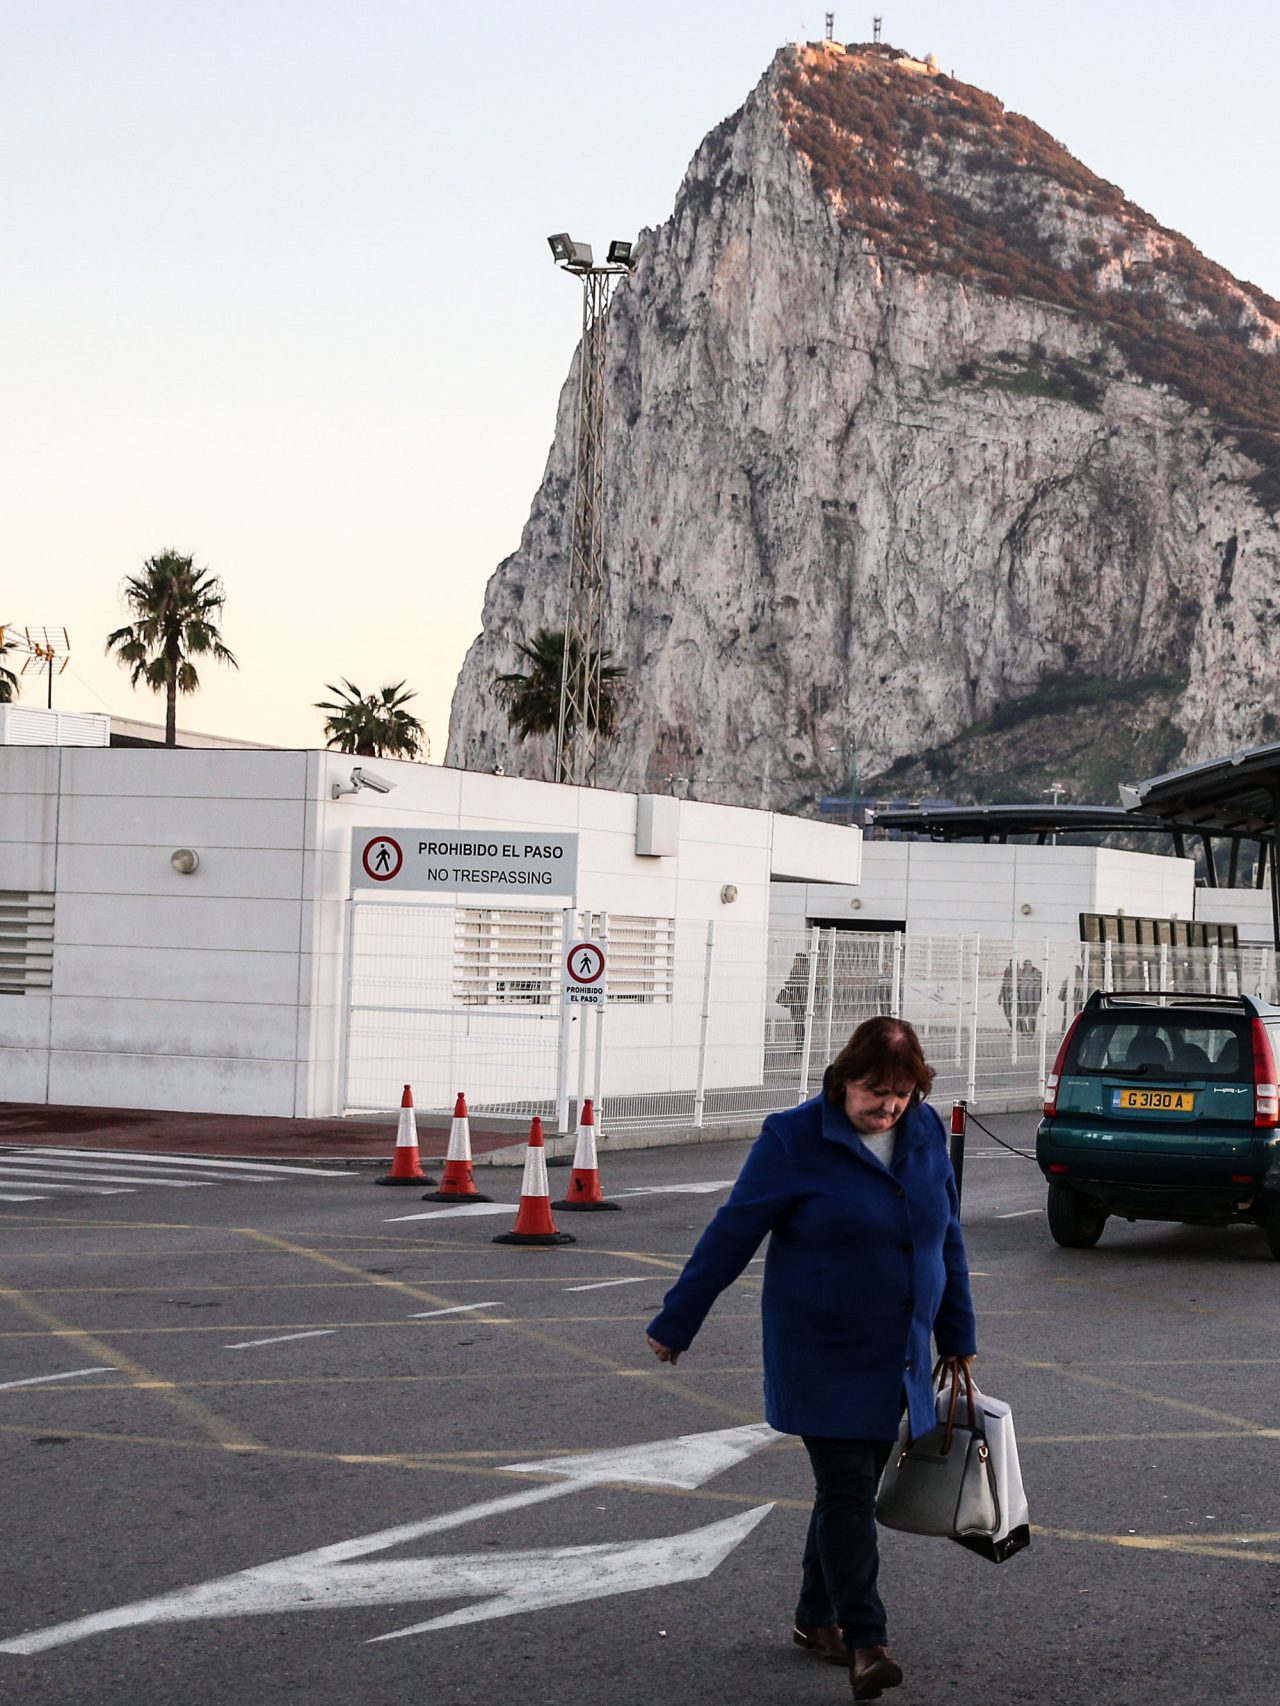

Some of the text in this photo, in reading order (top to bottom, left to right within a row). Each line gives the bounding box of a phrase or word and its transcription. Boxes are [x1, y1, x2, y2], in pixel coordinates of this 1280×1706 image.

[418, 842, 564, 859] PROHIBIDO EL PASO
[427, 868, 552, 885] NO TRESPASSING
[566, 986, 603, 994] PROHIBIDO
[580, 995, 598, 1003] PASO
[1128, 1093, 1137, 1106] G
[1140, 1093, 1171, 1108] 3130
[1175, 1095, 1183, 1108] A
